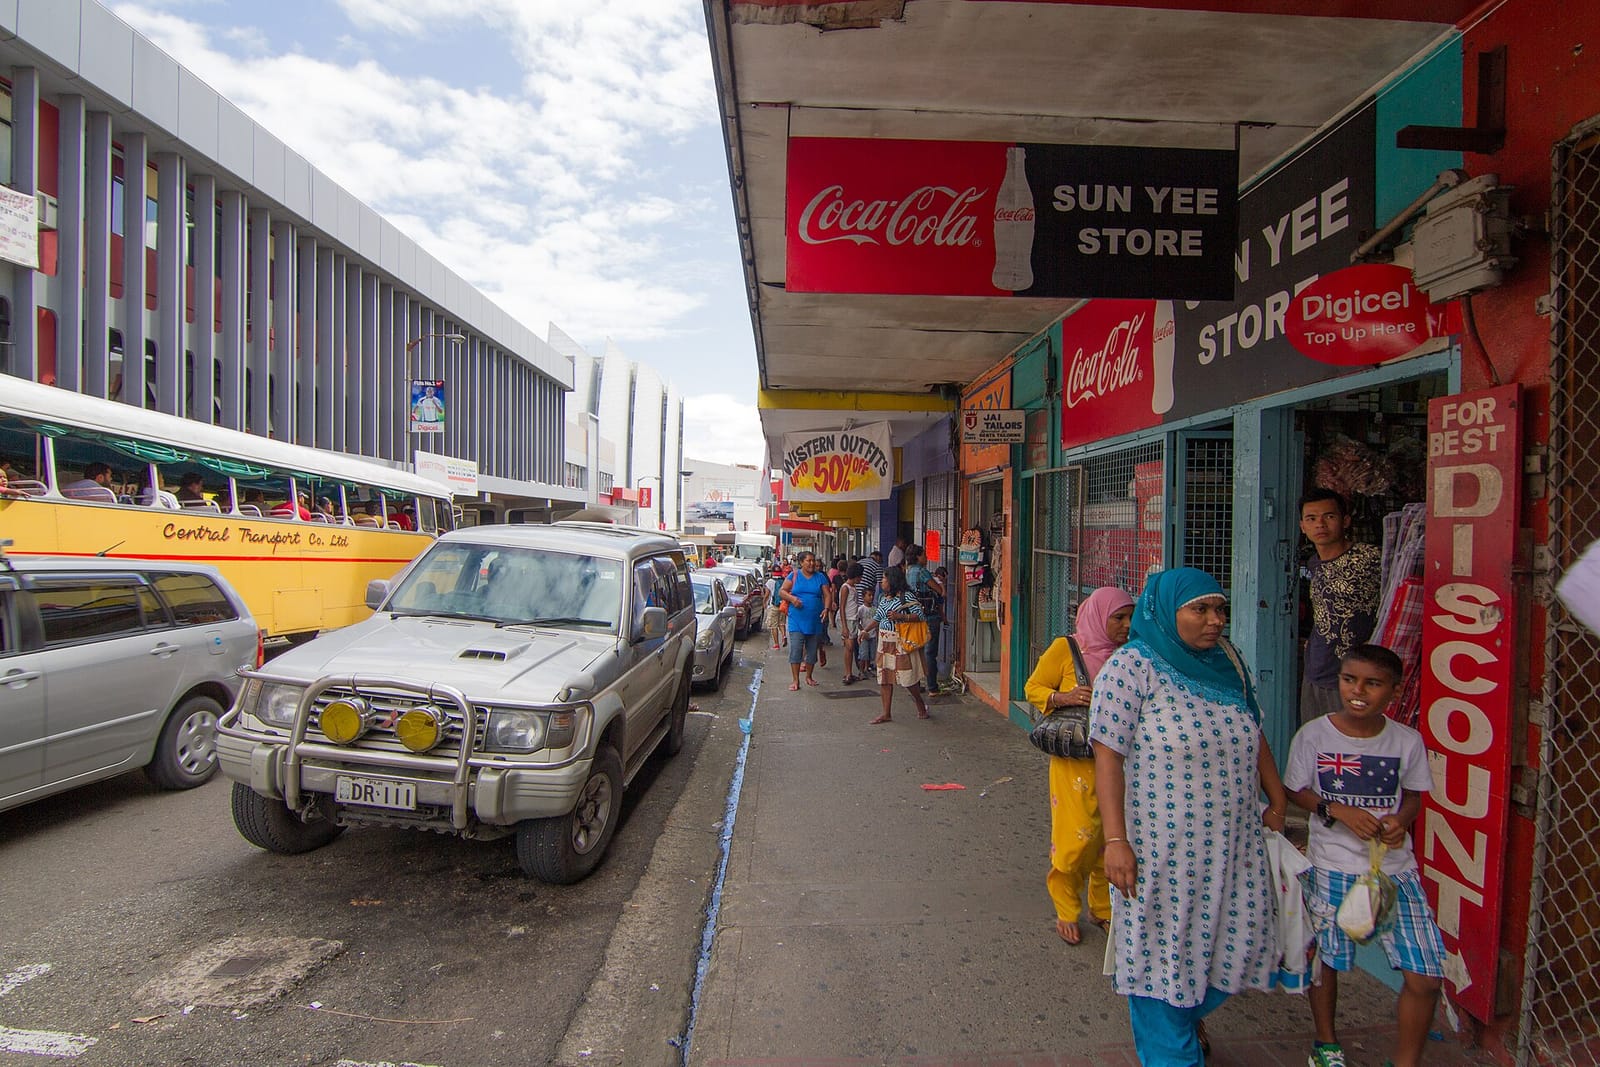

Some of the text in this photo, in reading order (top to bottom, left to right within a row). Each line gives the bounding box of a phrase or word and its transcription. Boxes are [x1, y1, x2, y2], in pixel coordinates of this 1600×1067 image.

[798, 185, 989, 247] Coca-Cola
[993, 207, 1034, 222] Coca-Cola
[1053, 184, 1219, 215] SUN YEE
[1262, 177, 1349, 269] YEE
[1077, 227, 1203, 258] STORE
[1302, 283, 1410, 323] Digicel
[1304, 320, 1416, 347] Top Up Here
[1066, 311, 1145, 408] Coca-Cola
[983, 413, 1001, 421] JAI
[984, 422, 1022, 430] TAILORS
[1441, 396, 1496, 430] FOR
[783, 433, 889, 478] WESTERN OUTFITS
[1429, 424, 1505, 460] BEST
[813, 453, 853, 494] 50%
[852, 457, 870, 476] OFF
[163, 523, 349, 555] Central Transport Co. Ltd
[1423, 463, 1503, 940] DISCOUNT
[1320, 792, 1396, 808] AUSTRALIA
